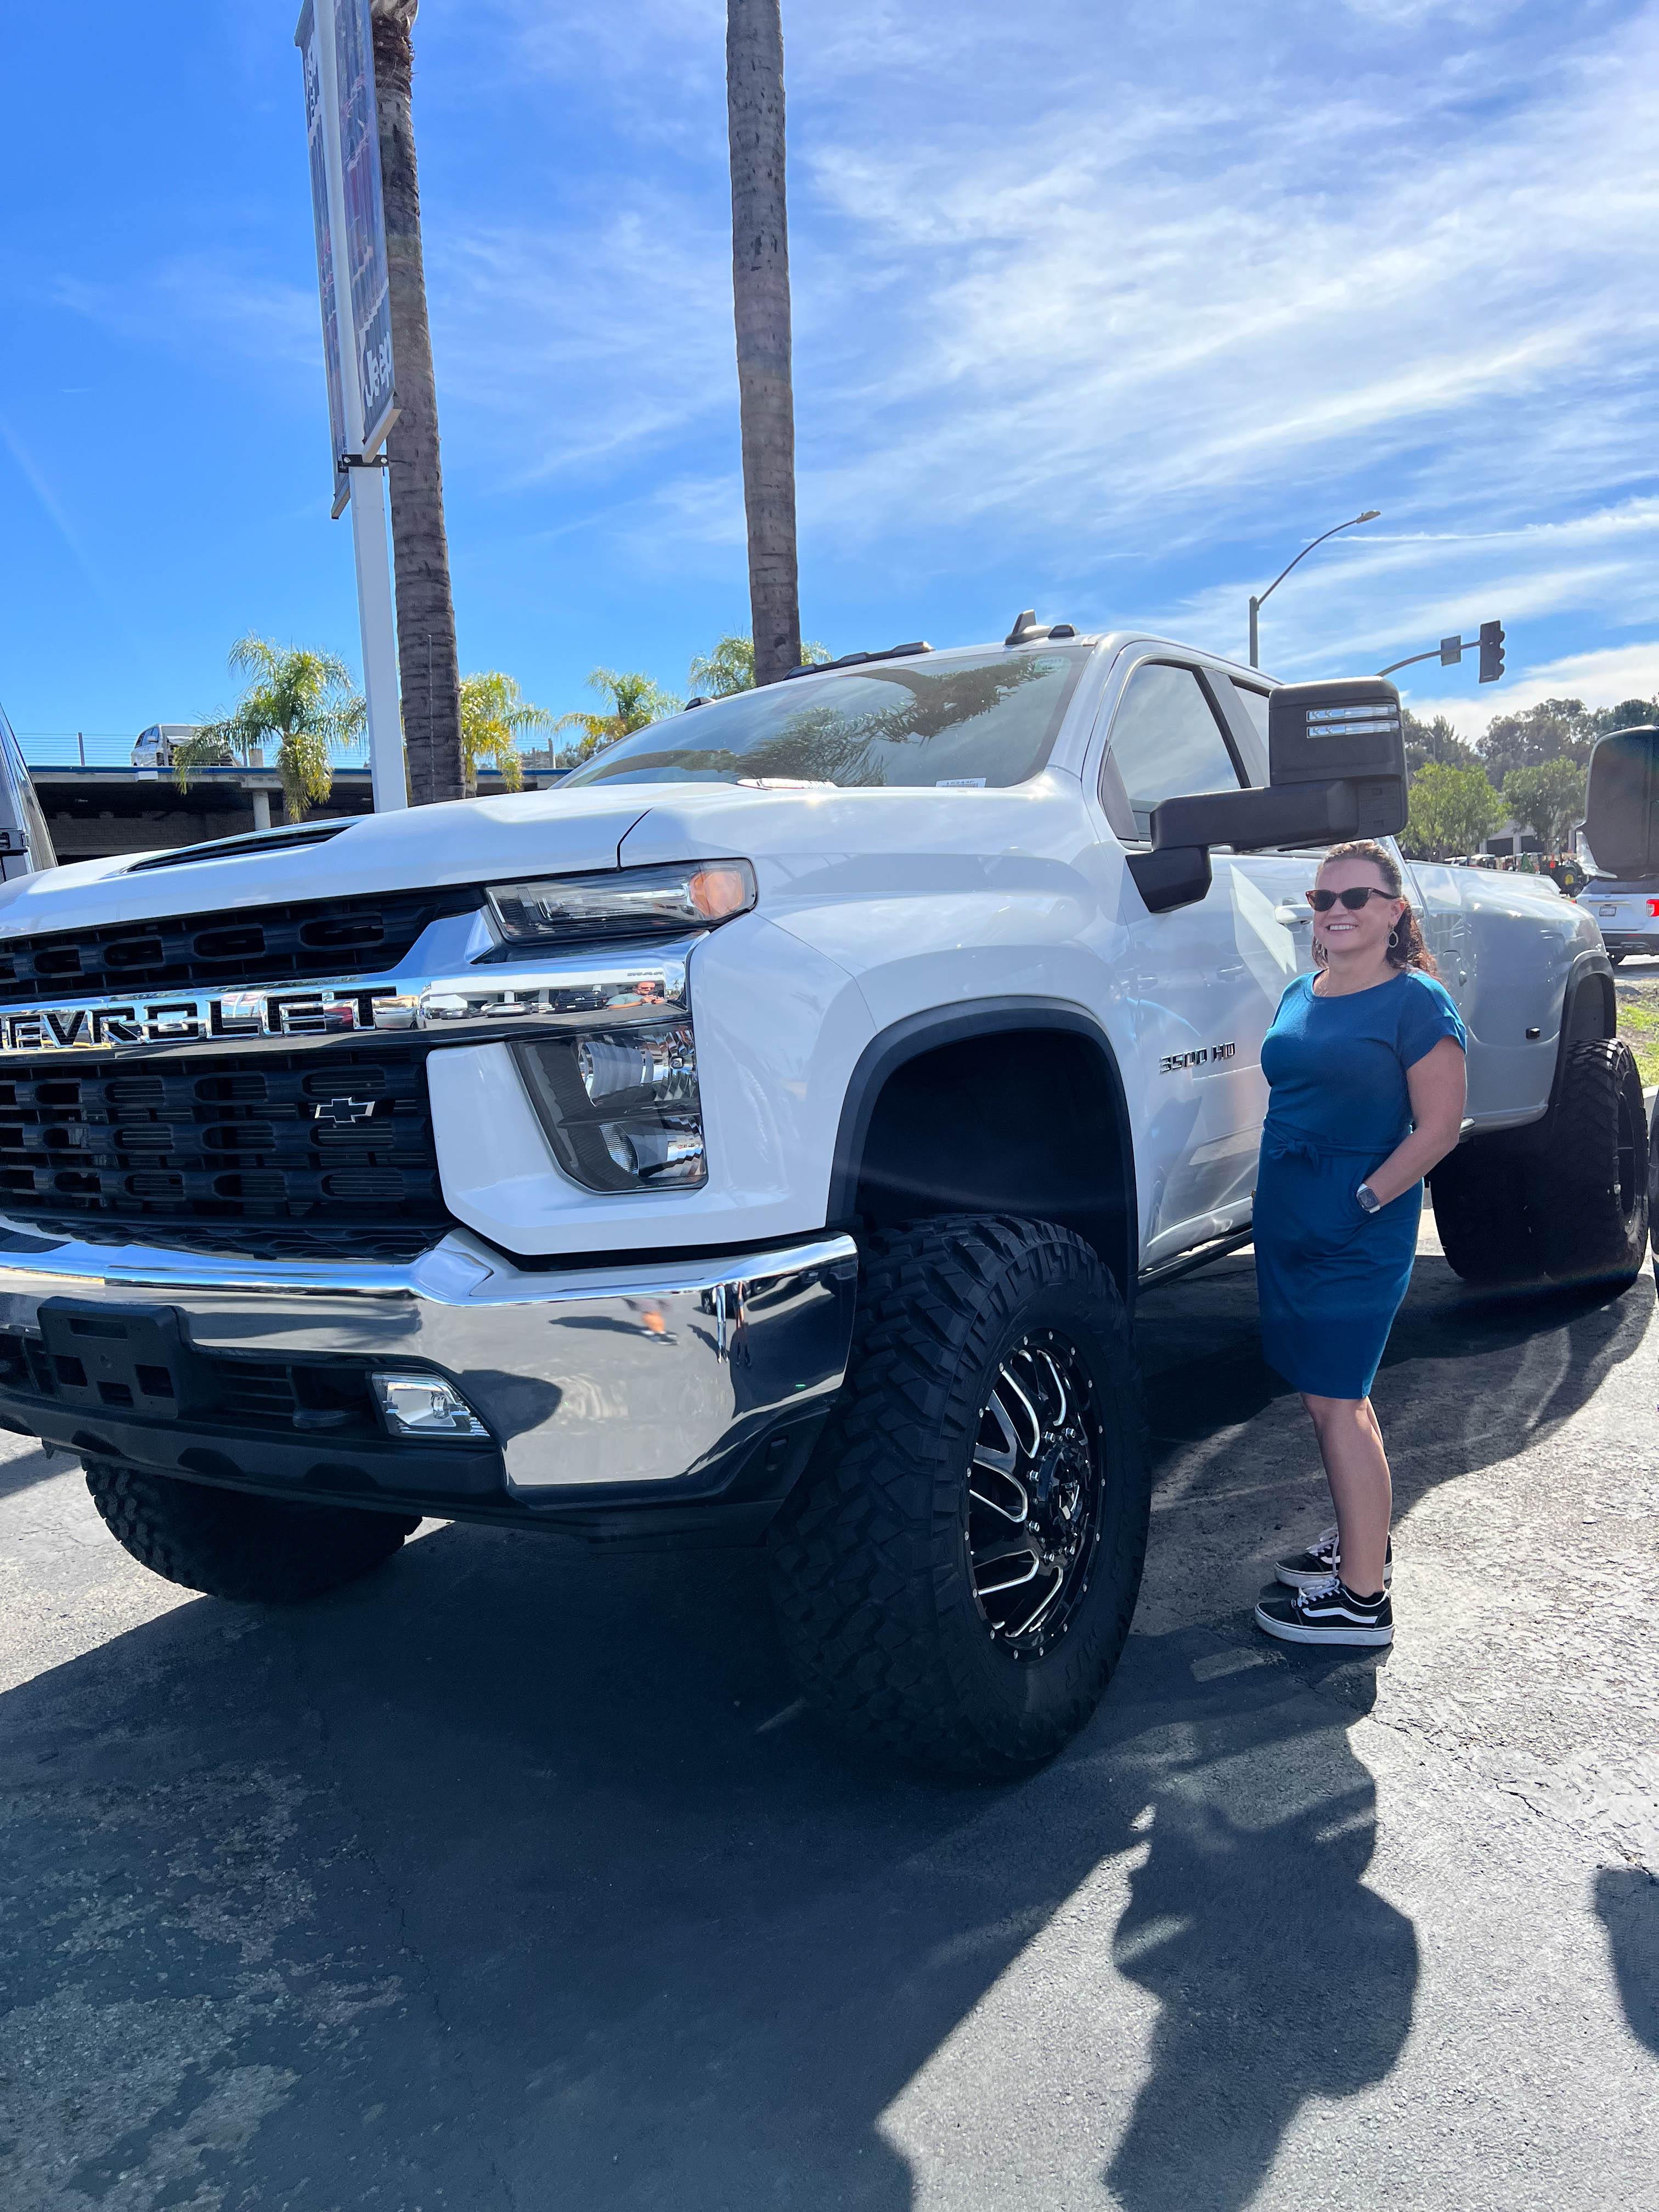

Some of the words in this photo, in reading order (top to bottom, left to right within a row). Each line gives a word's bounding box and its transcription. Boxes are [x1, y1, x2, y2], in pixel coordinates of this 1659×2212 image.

[365, 331, 392, 407] Jeep
[0, 986, 397, 1051] EVROLET
[1159, 1047, 1207, 1074] 3500
[1211, 1041, 1235, 1062] HD
